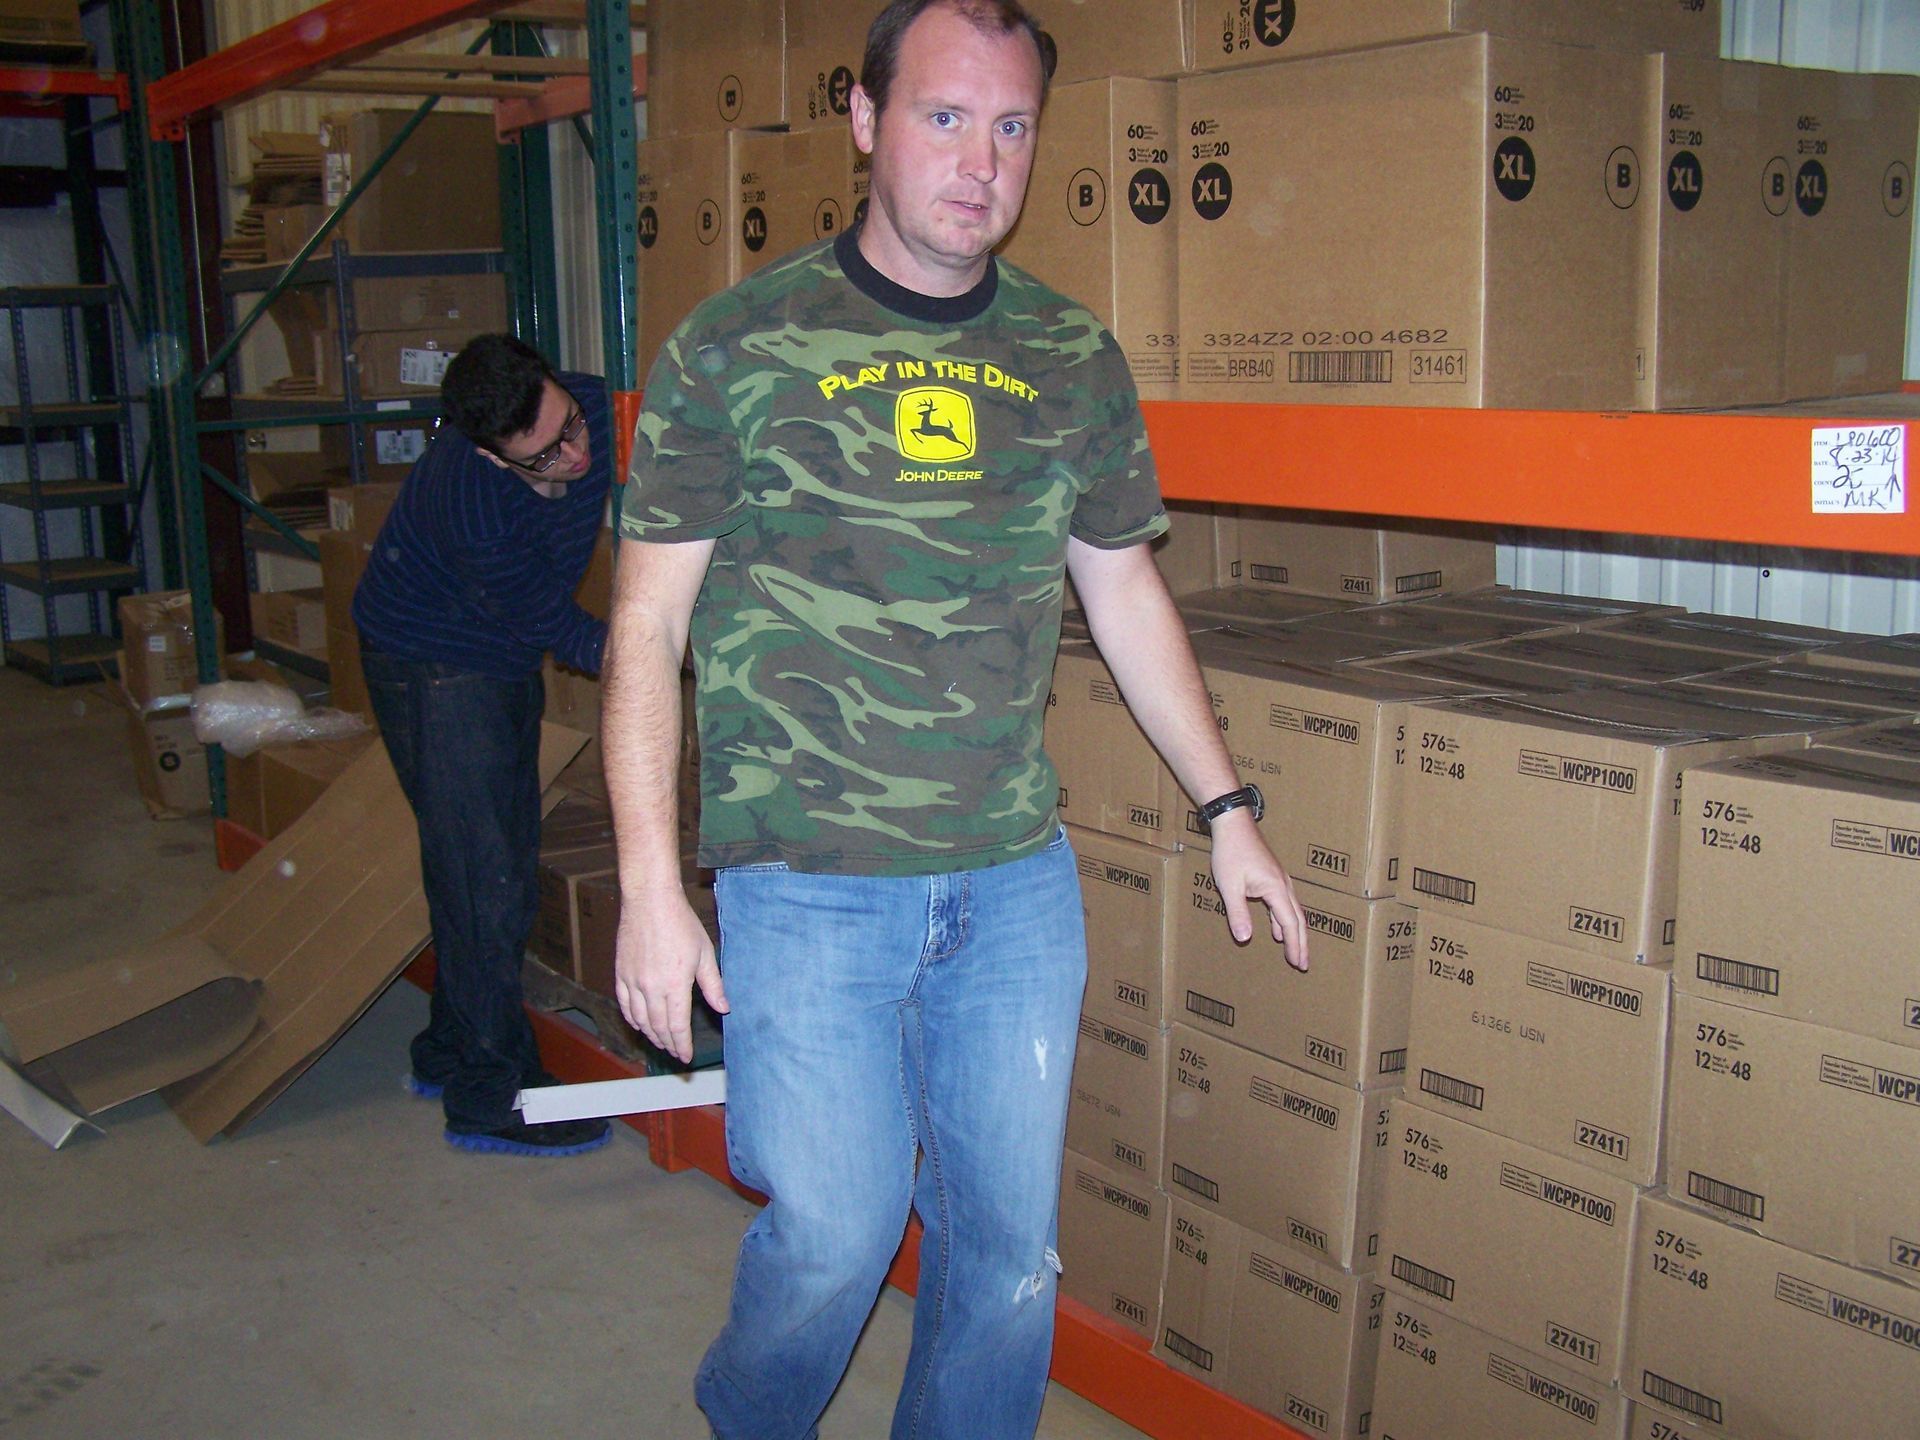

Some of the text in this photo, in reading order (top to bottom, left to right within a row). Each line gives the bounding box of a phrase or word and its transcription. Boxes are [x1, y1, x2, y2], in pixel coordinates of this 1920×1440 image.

[1264, 0, 1281, 39] XL
[1223, 31, 1233, 54] 60
[1240, 39, 1249, 50] 3
[726, 90, 736, 107] B
[818, 72, 827, 117] 3 20
[834, 72, 848, 109] XL
[1494, 86, 1511, 103] 60
[809, 102, 816, 119] 60
[1669, 104, 1683, 120] 60
[1127, 125, 1144, 139] 60
[1191, 120, 1206, 136] 60
[1495, 113, 1534, 132] 3 20
[1797, 117, 1810, 131] 60
[1669, 129, 1702, 146] 3 20
[1797, 140, 1827, 155] 3 20
[1128, 148, 1168, 163] 3 20
[1192, 142, 1230, 159] 3 20
[853, 161, 864, 173] 60
[1499, 153, 1530, 180] XL
[1617, 163, 1631, 188] B
[741, 173, 752, 185] 60
[853, 182, 859, 194] 3
[1197, 178, 1227, 202] XL
[1672, 166, 1698, 192] XL
[1773, 173, 1784, 196] B
[1800, 175, 1824, 198] XL
[1892, 177, 1902, 199] B
[742, 191, 765, 202] 3 20
[1079, 184, 1093, 207] B
[1134, 183, 1165, 206] XL
[640, 217, 656, 235] XL
[702, 212, 711, 230] B
[745, 218, 765, 238] XL
[822, 212, 833, 231] B
[1204, 329, 1448, 347] 3324Z2 02:00 4682
[1229, 358, 1273, 377] BRB40
[1413, 354, 1464, 376] 31461
[818, 360, 1039, 402] PLAY IN THE DIRT
[895, 470, 983, 482] JOHN DEERE
[1344, 578, 1370, 592] 27411
[1304, 714, 1357, 741] WCPP1000
[1421, 732, 1446, 752] 576
[1420, 756, 1432, 773] 12
[1448, 762, 1465, 780] 48
[1563, 761, 1634, 791] WCPP1000
[1130, 808, 1160, 828] 27411
[1703, 800, 1735, 821] 576
[1702, 828, 1718, 847] 12
[1739, 834, 1761, 854] 48
[1311, 850, 1346, 873] 27411
[1106, 866, 1149, 892] WCPP1000
[1193, 872, 1212, 891] 576
[1193, 893, 1227, 917] 12 48
[1387, 921, 1412, 939] 576
[1573, 912, 1619, 938] 27411
[1386, 946, 1400, 961] 12
[1430, 936, 1455, 956] 576
[1428, 959, 1474, 985] 12 48
[1118, 985, 1146, 1007] 27411
[1570, 977, 1639, 1012] WCPP1000
[1104, 1028, 1146, 1057] WCPP1000
[1520, 1025, 1545, 1044] USN
[1696, 1023, 1727, 1047] 576
[1179, 1048, 1197, 1068] 576
[1309, 1041, 1343, 1067] 27411
[1695, 1049, 1711, 1070] 12
[1730, 1060, 1751, 1081] 48
[1178, 1068, 1210, 1094] 12 48
[1284, 1093, 1336, 1126] WCPP1000
[1404, 1128, 1430, 1150] 576
[1579, 1127, 1624, 1156] 27411
[1115, 1143, 1143, 1167] 27411
[1403, 1150, 1448, 1180] 12 48
[1104, 1186, 1149, 1217] WCPP1000
[1543, 1181, 1612, 1222] WCPP1000
[1176, 1218, 1194, 1238] 576
[1291, 1223, 1324, 1249] 27411
[1176, 1236, 1207, 1265] 12 48
[1655, 1230, 1685, 1254] 576
[1653, 1254, 1708, 1290] 12 48
[1284, 1272, 1338, 1309] WCPP1000
[1115, 1298, 1144, 1322] 27411
[1368, 1315, 1380, 1330] 12
[1395, 1312, 1419, 1334] 576
[1393, 1333, 1436, 1365] 12 48
[1551, 1328, 1595, 1359] 27411
[1530, 1376, 1595, 1420] WCPP1000
[1288, 1400, 1324, 1428] 27411
